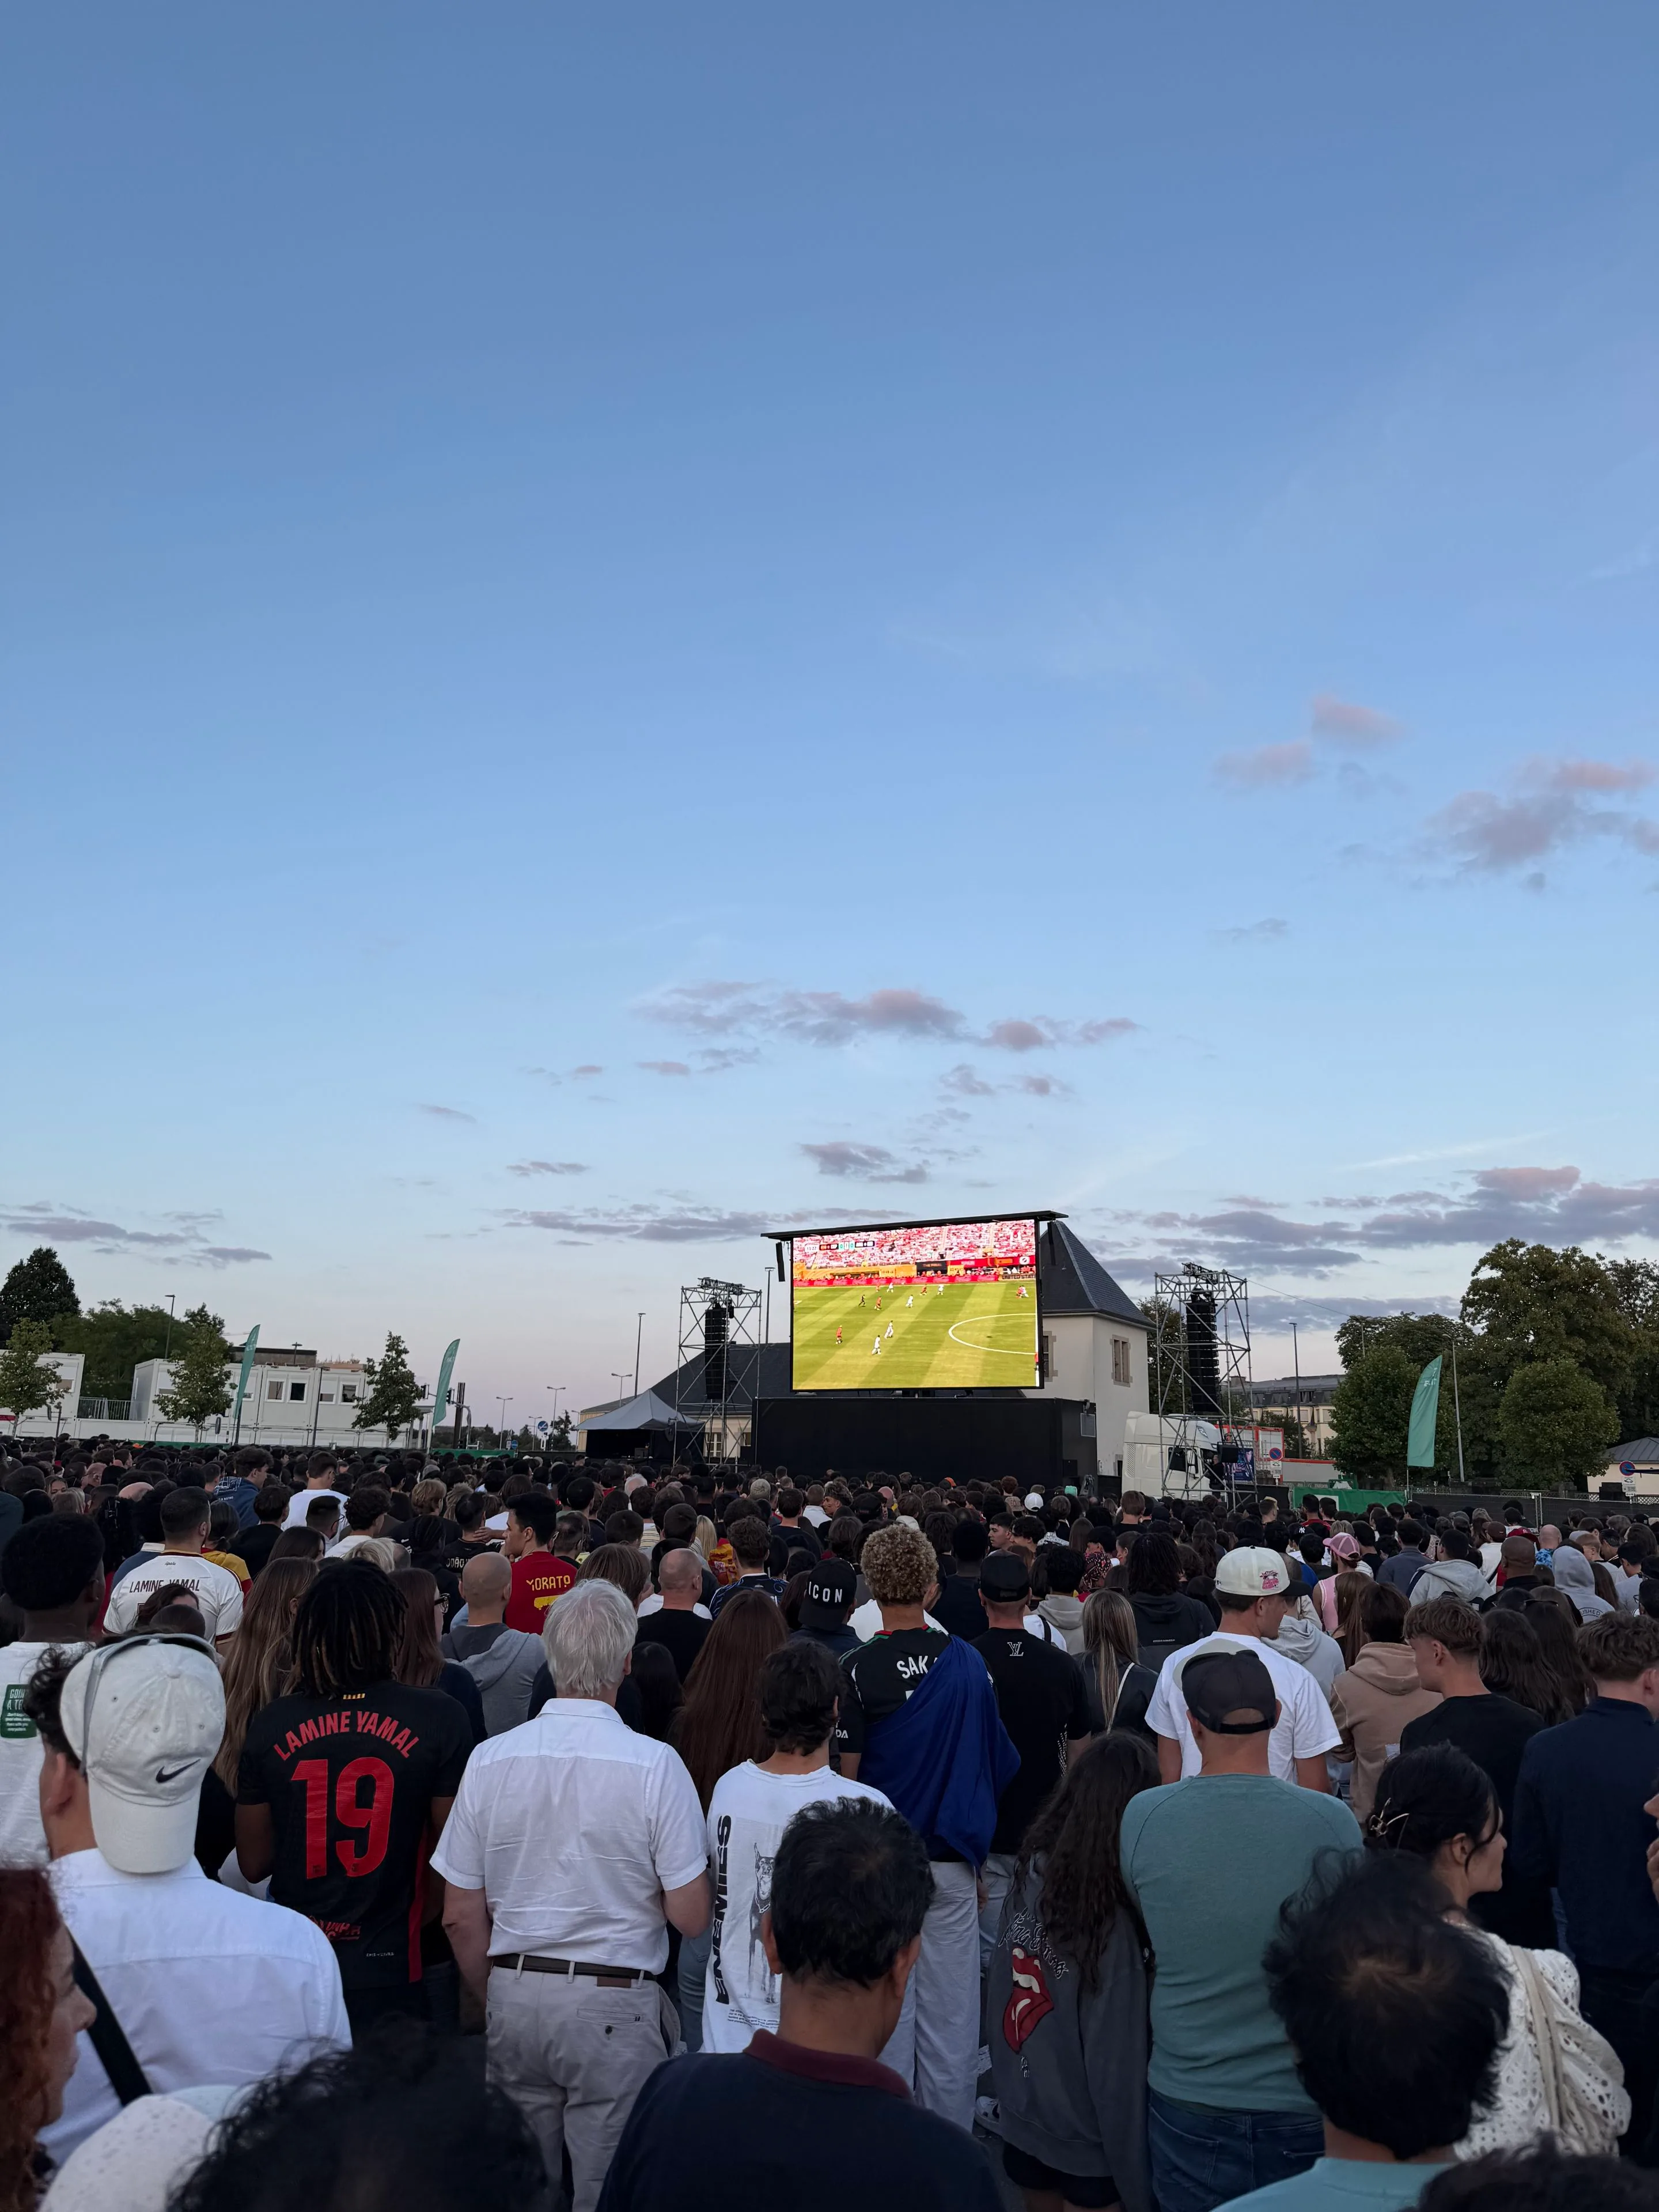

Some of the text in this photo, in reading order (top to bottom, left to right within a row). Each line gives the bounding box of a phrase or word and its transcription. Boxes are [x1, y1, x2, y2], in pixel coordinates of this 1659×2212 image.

[808, 1581, 843, 1603] ICON
[896, 1655, 938, 1679] SAK
[9, 1688, 28, 1699] GOIN
[273, 1710, 419, 1761] LAMINE YAMAL
[291, 1757, 394, 1879] 19
[712, 1815, 732, 2005] ENEMIES
